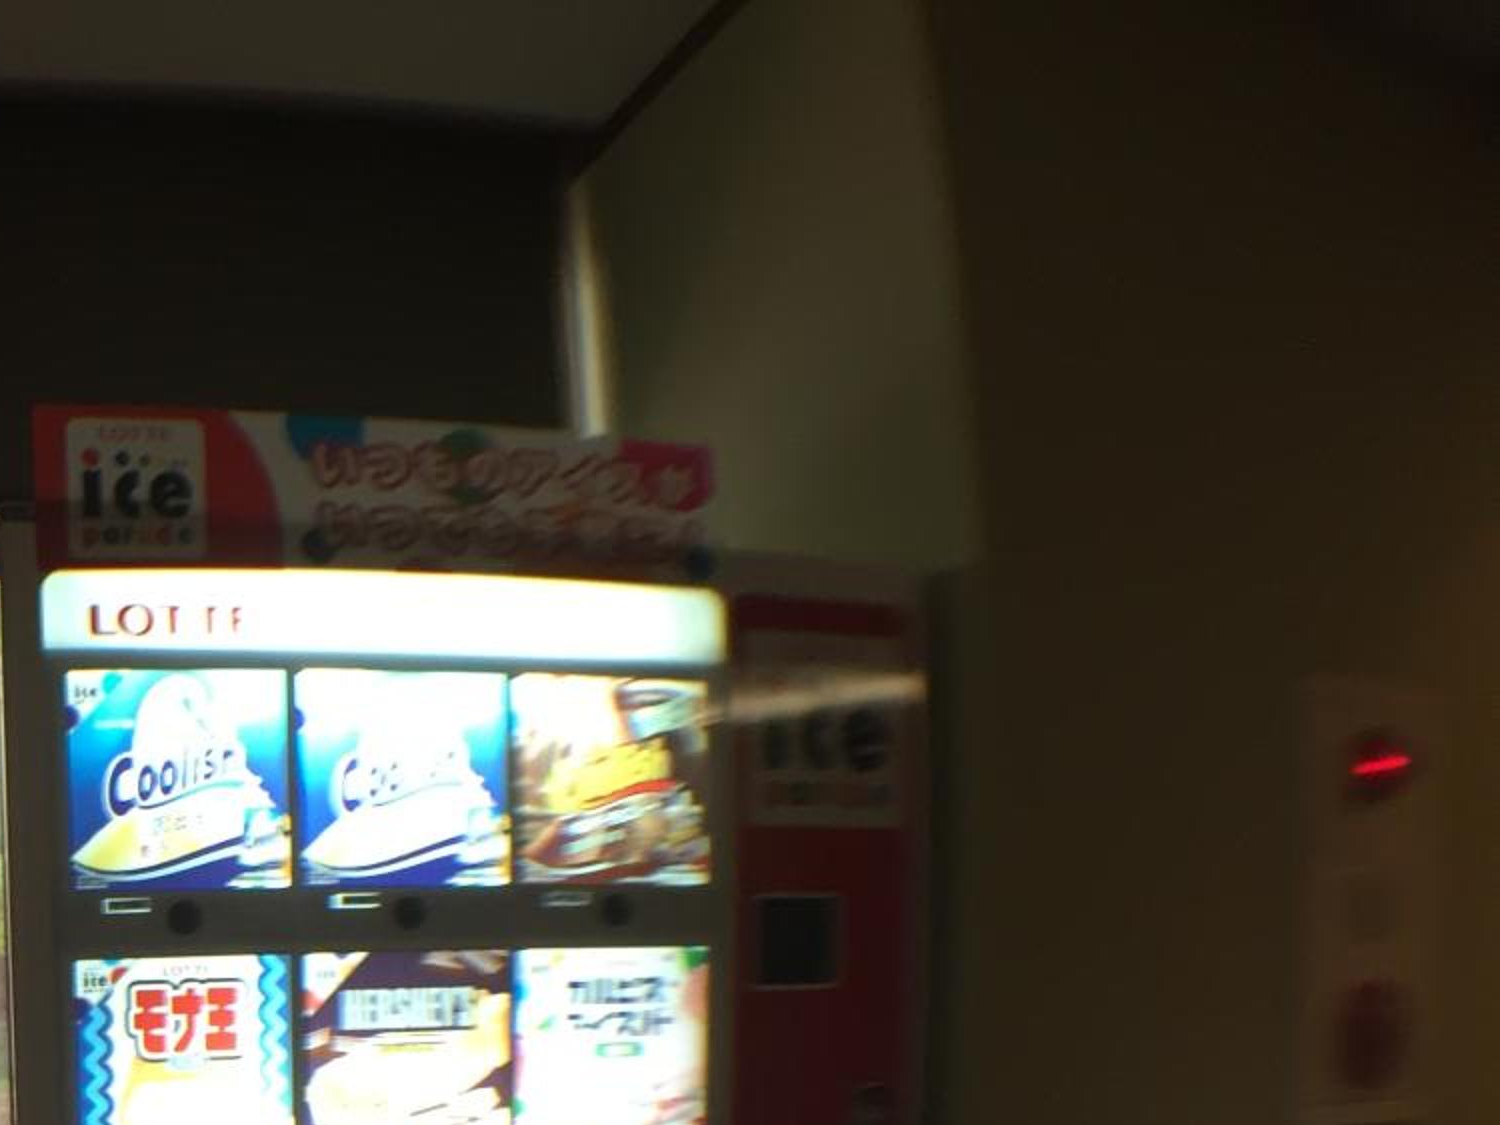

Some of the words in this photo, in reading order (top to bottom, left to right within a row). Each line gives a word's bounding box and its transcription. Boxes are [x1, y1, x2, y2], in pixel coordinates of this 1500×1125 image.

[81, 448, 193, 518] ice
[134, 987, 238, 1053] モナ王
